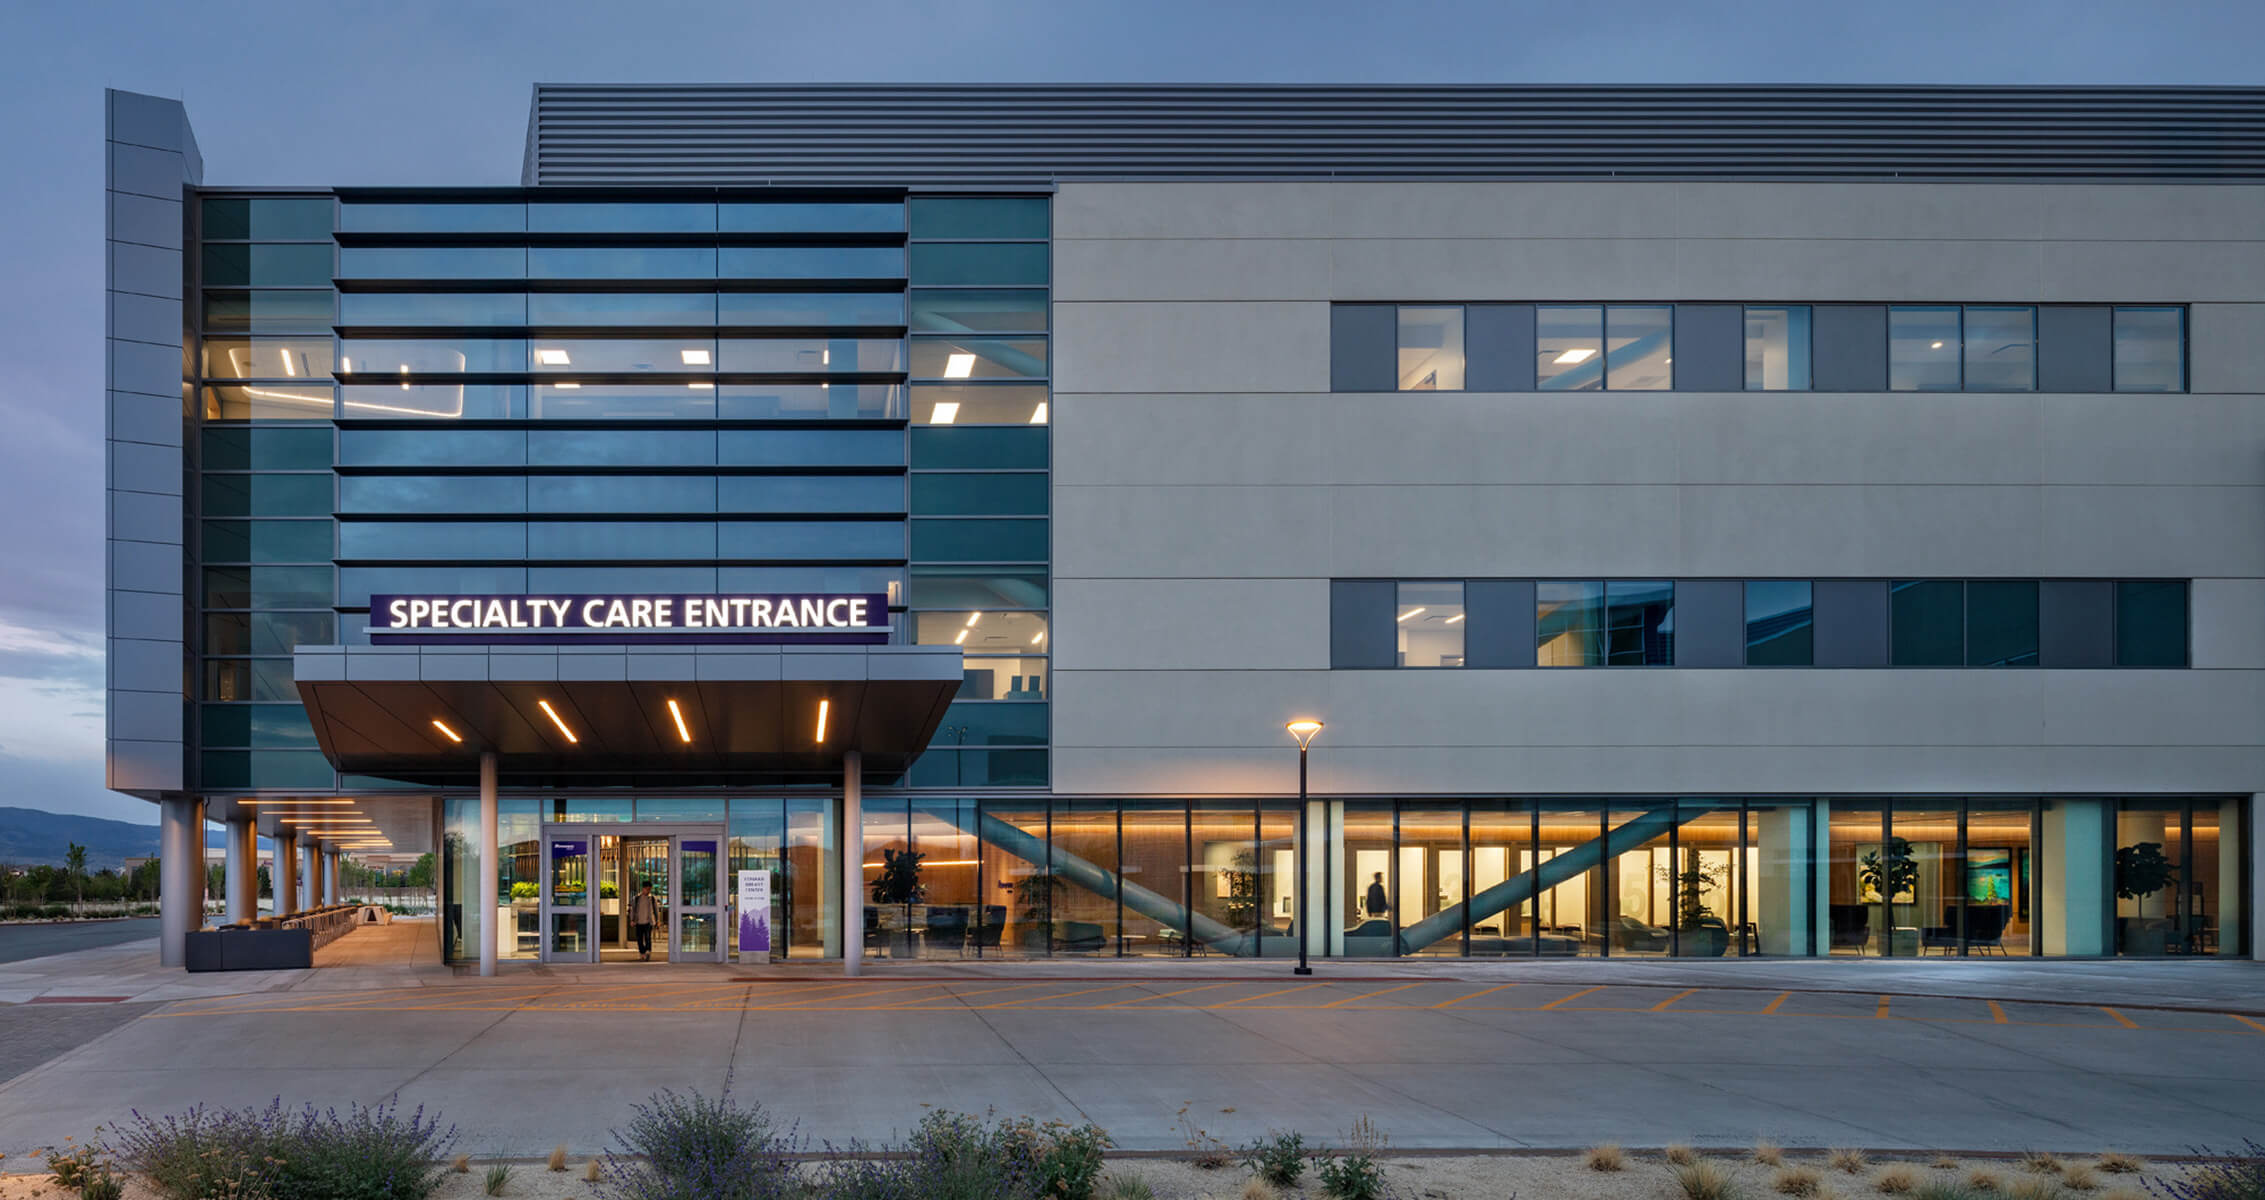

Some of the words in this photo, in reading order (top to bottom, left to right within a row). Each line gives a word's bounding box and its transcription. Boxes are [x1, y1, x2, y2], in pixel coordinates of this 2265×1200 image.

[389, 599, 572, 628] SPECIALTY
[582, 599, 673, 628] CARE
[684, 598, 868, 628] ENTRANCE
